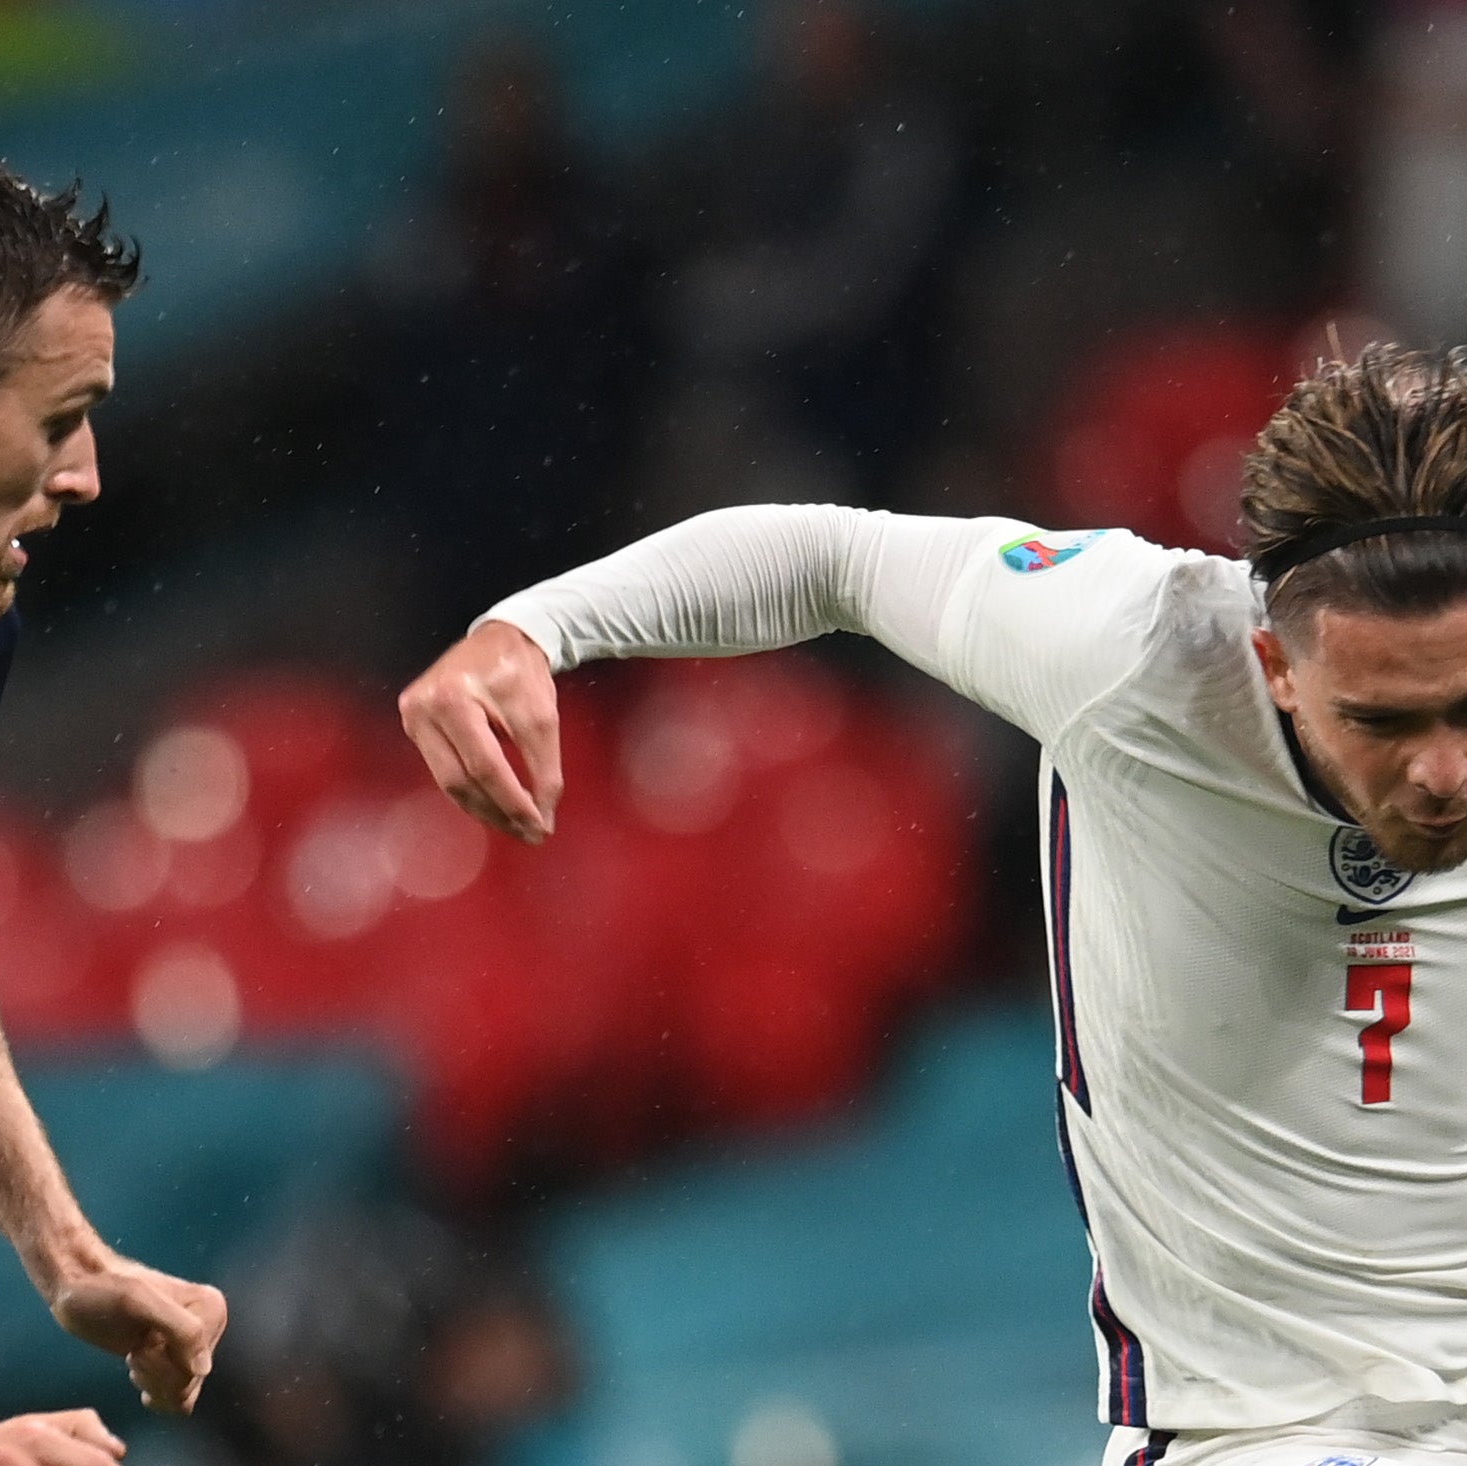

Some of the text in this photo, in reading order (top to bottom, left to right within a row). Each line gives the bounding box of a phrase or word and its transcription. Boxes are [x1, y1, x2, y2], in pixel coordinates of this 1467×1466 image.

[1350, 932, 1411, 945] SCOTLAND
[1361, 946, 1389, 958] JUNE
[1345, 964, 1412, 1104] 7
